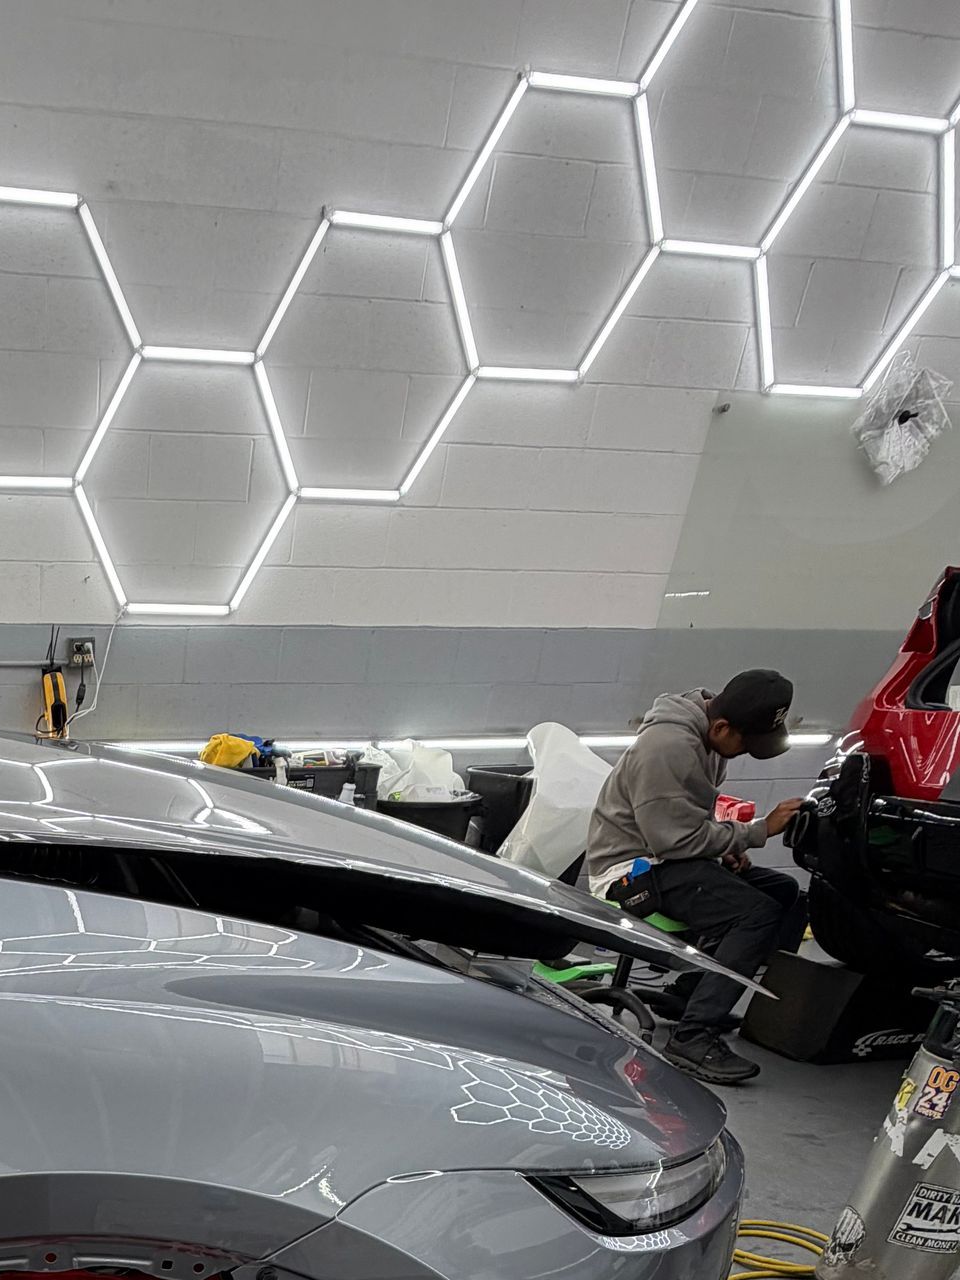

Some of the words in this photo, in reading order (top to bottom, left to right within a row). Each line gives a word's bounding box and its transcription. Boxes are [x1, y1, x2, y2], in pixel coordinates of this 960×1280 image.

[872, 1034, 913, 1046] RACE
[919, 1188, 950, 1201] DIRTY
[895, 1232, 925, 1246] CLEAN
[924, 1239, 957, 1249] MONEY
